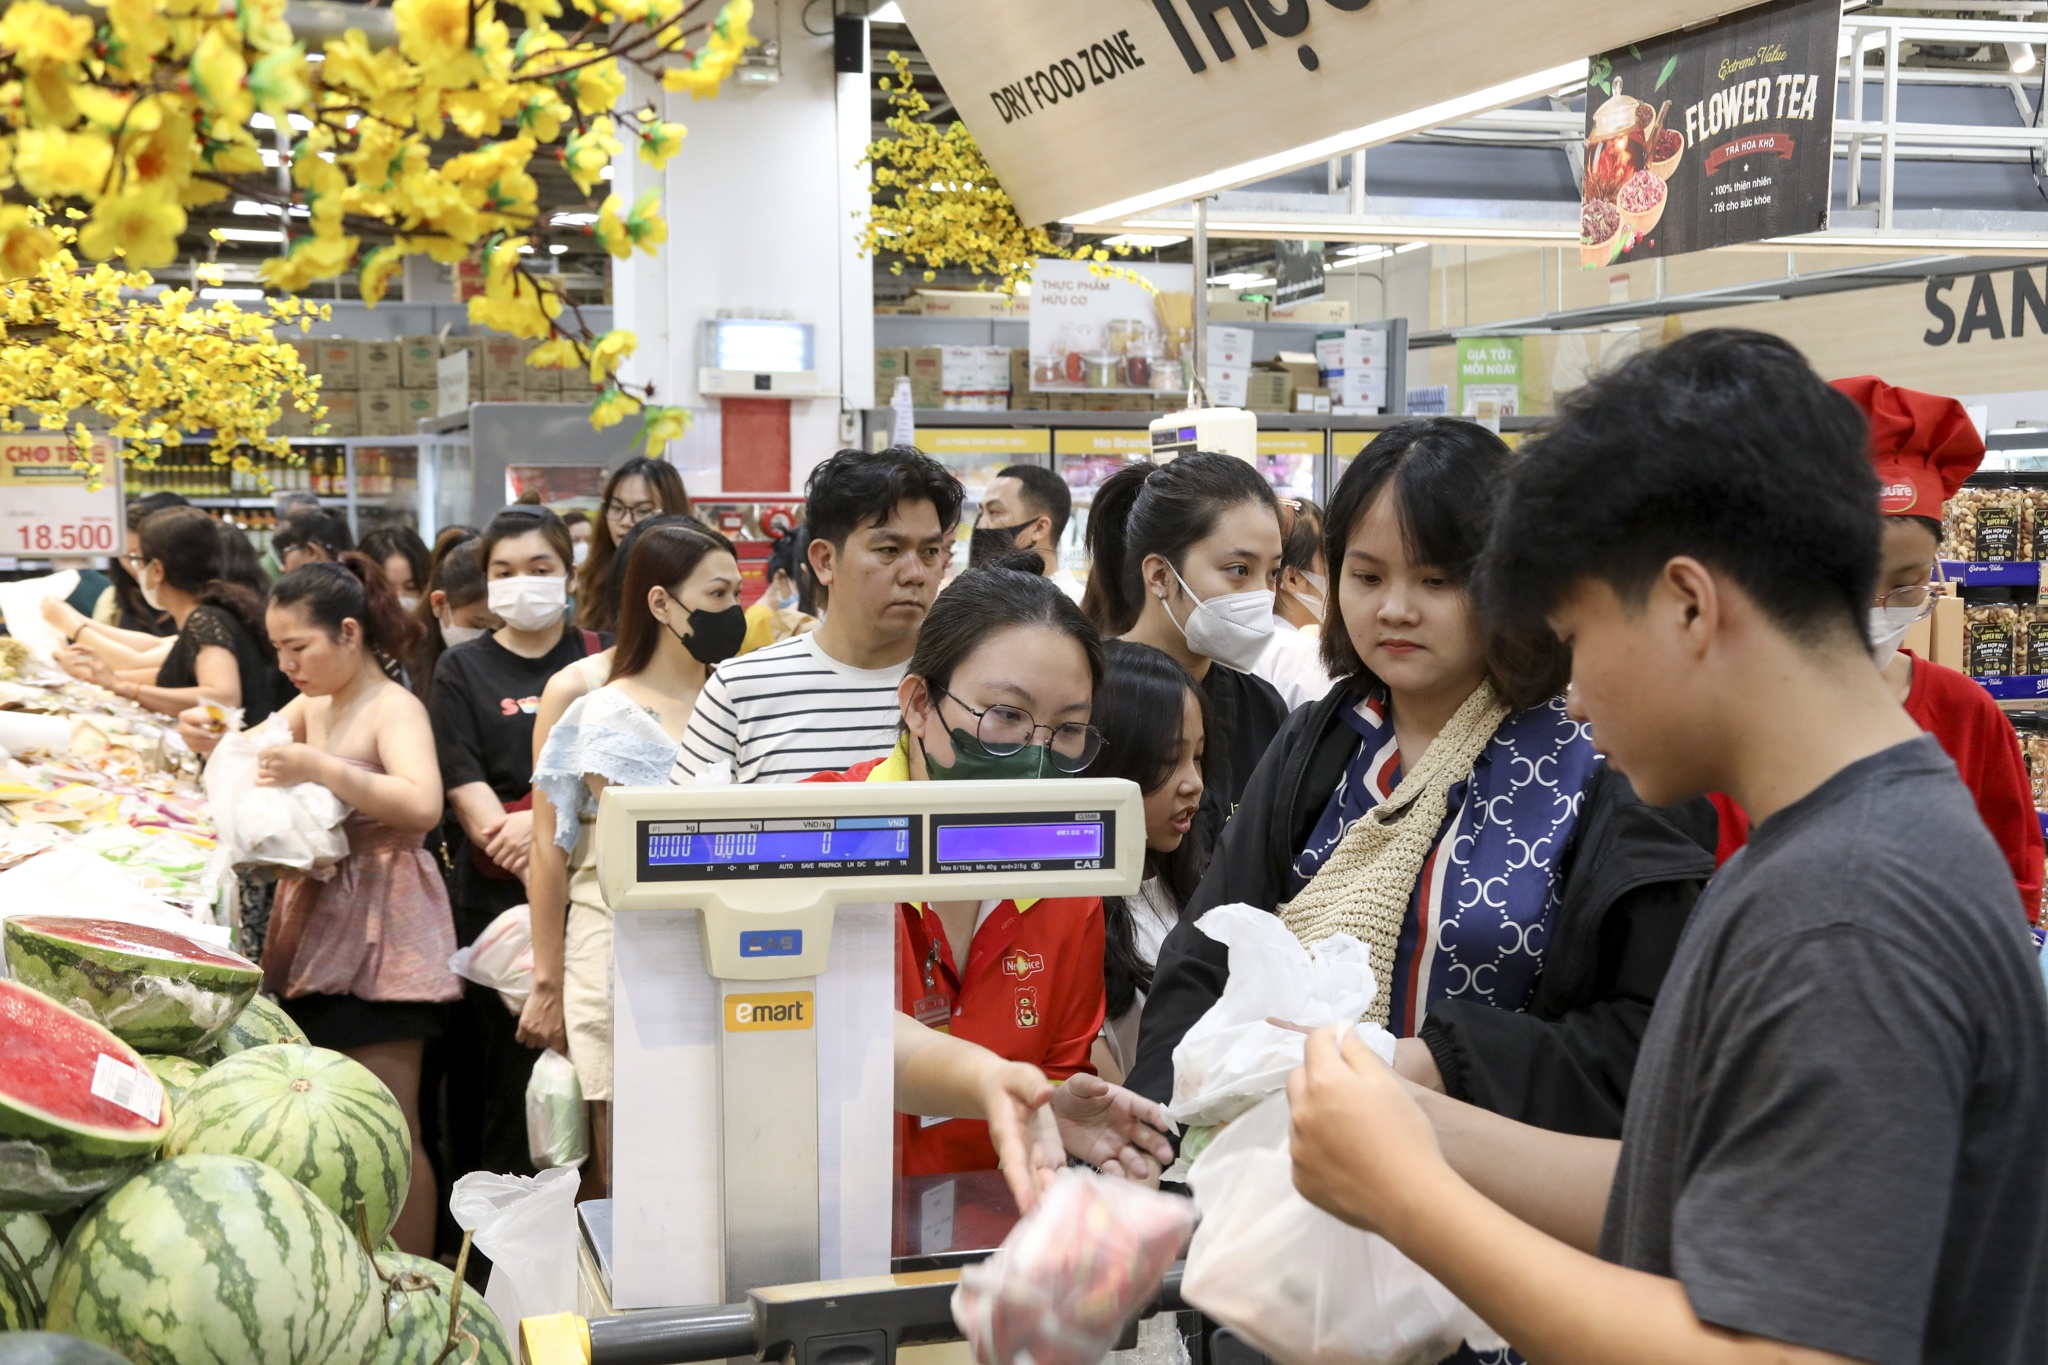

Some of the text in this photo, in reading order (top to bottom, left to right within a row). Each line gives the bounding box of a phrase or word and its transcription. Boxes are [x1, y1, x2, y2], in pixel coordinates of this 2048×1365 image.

[1718, 44, 1787, 81] Extreme Value
[989, 29, 1146, 124] DRY FOOD ZONE
[1685, 74, 1819, 149] FLOWER TEA
[1725, 135, 1775, 157] TRÀ HOA KHÔ
[1715, 175, 1772, 196] 100% thiên nhiên
[1726, 198, 1739, 211] cho
[1740, 196, 1753, 208] sức
[1923, 269, 2048, 346] SAN
[1093, 436, 1112, 449] No
[18, 525, 112, 550] 18.500
[1969, 564, 1988, 573] Extreme
[1988, 678, 2003, 686] Value
[685, 825, 696, 833] kg
[749, 823, 759, 831] kg
[803, 820, 831, 830] VND/kg
[887, 819, 905, 827] VND
[821, 831, 832, 854] 0
[896, 829, 906, 852] 0
[952, 864, 972, 872] 6/15kg
[1074, 860, 1101, 869] CAS
[748, 936, 794, 951] CAS
[735, 1000, 804, 1024] emart
